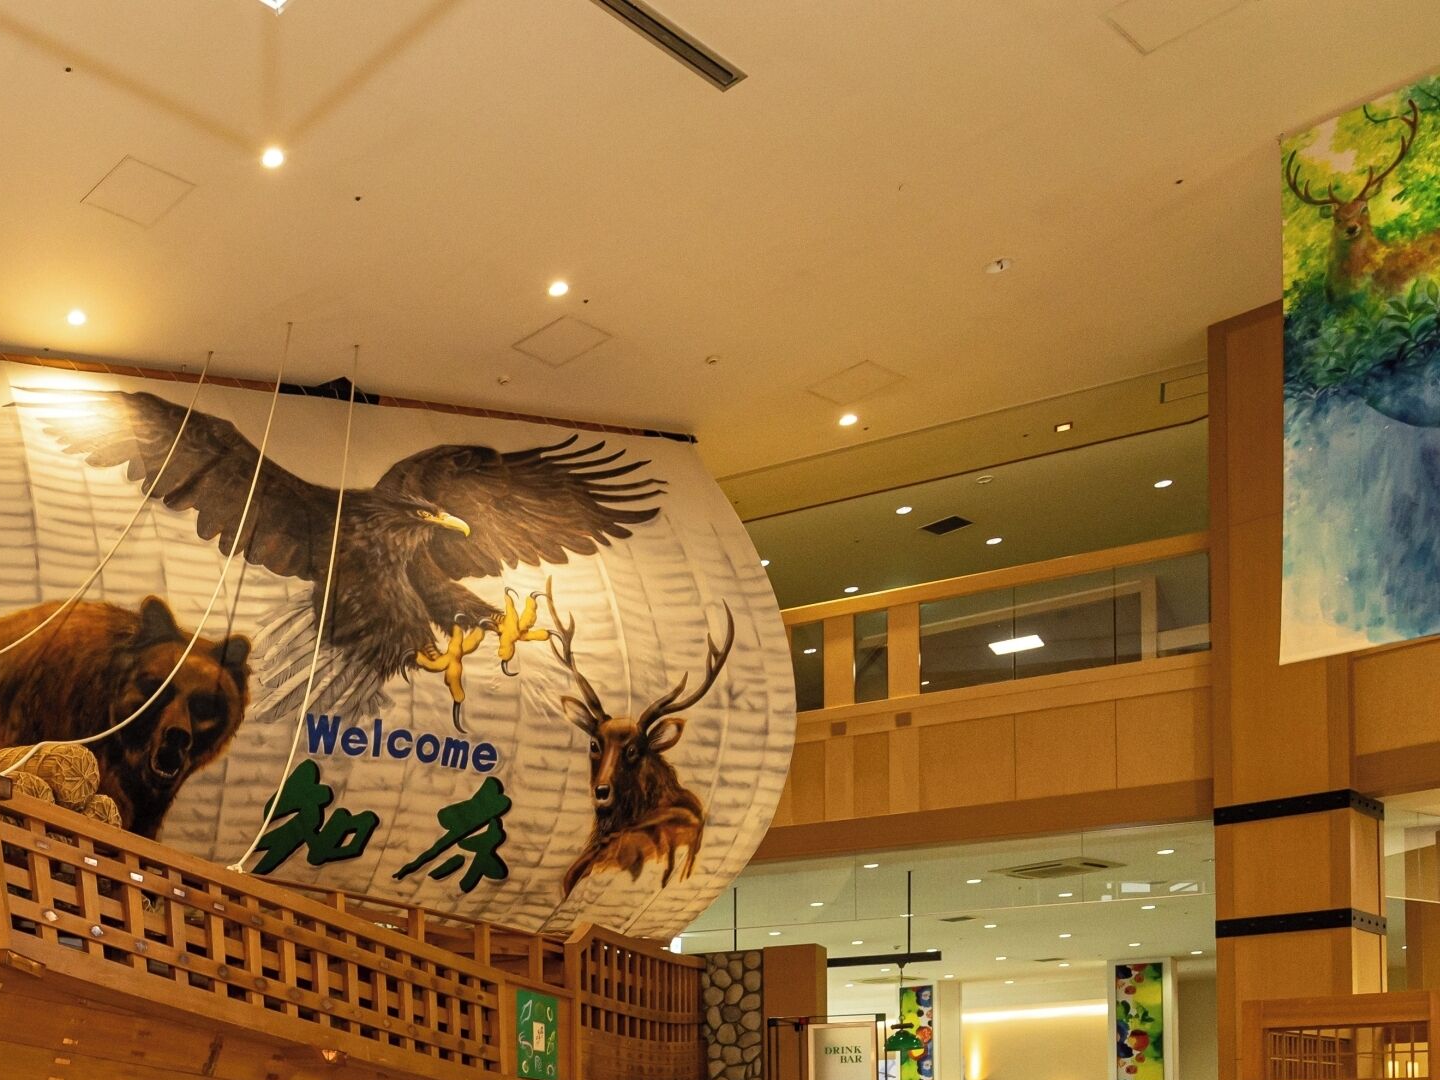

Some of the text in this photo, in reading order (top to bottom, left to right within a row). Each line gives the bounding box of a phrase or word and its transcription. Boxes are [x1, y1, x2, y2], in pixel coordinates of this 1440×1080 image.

[305, 712, 498, 773] Welcome
[824, 1045, 862, 1055] DRINK
[839, 1054, 863, 1064] BAR
